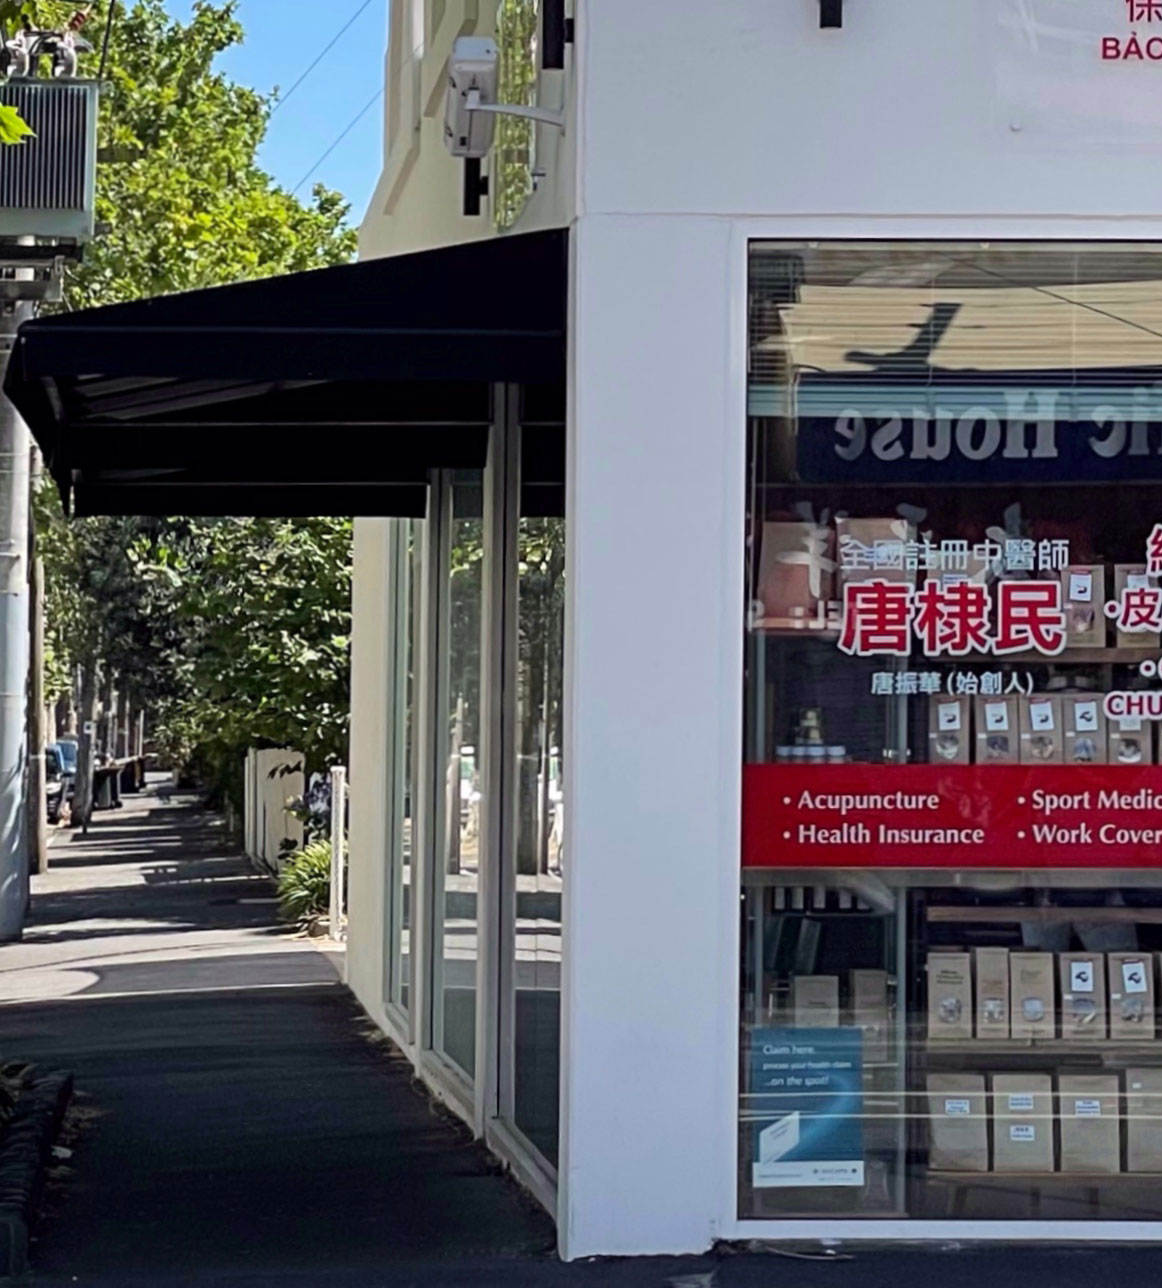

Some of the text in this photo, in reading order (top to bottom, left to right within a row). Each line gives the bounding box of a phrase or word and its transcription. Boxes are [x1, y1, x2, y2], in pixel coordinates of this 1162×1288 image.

[798, 790, 940, 815] Acupuncture
[1032, 789, 1091, 816] Sport
[798, 824, 985, 844] Health Insurance
[1032, 824, 1092, 844] Work
